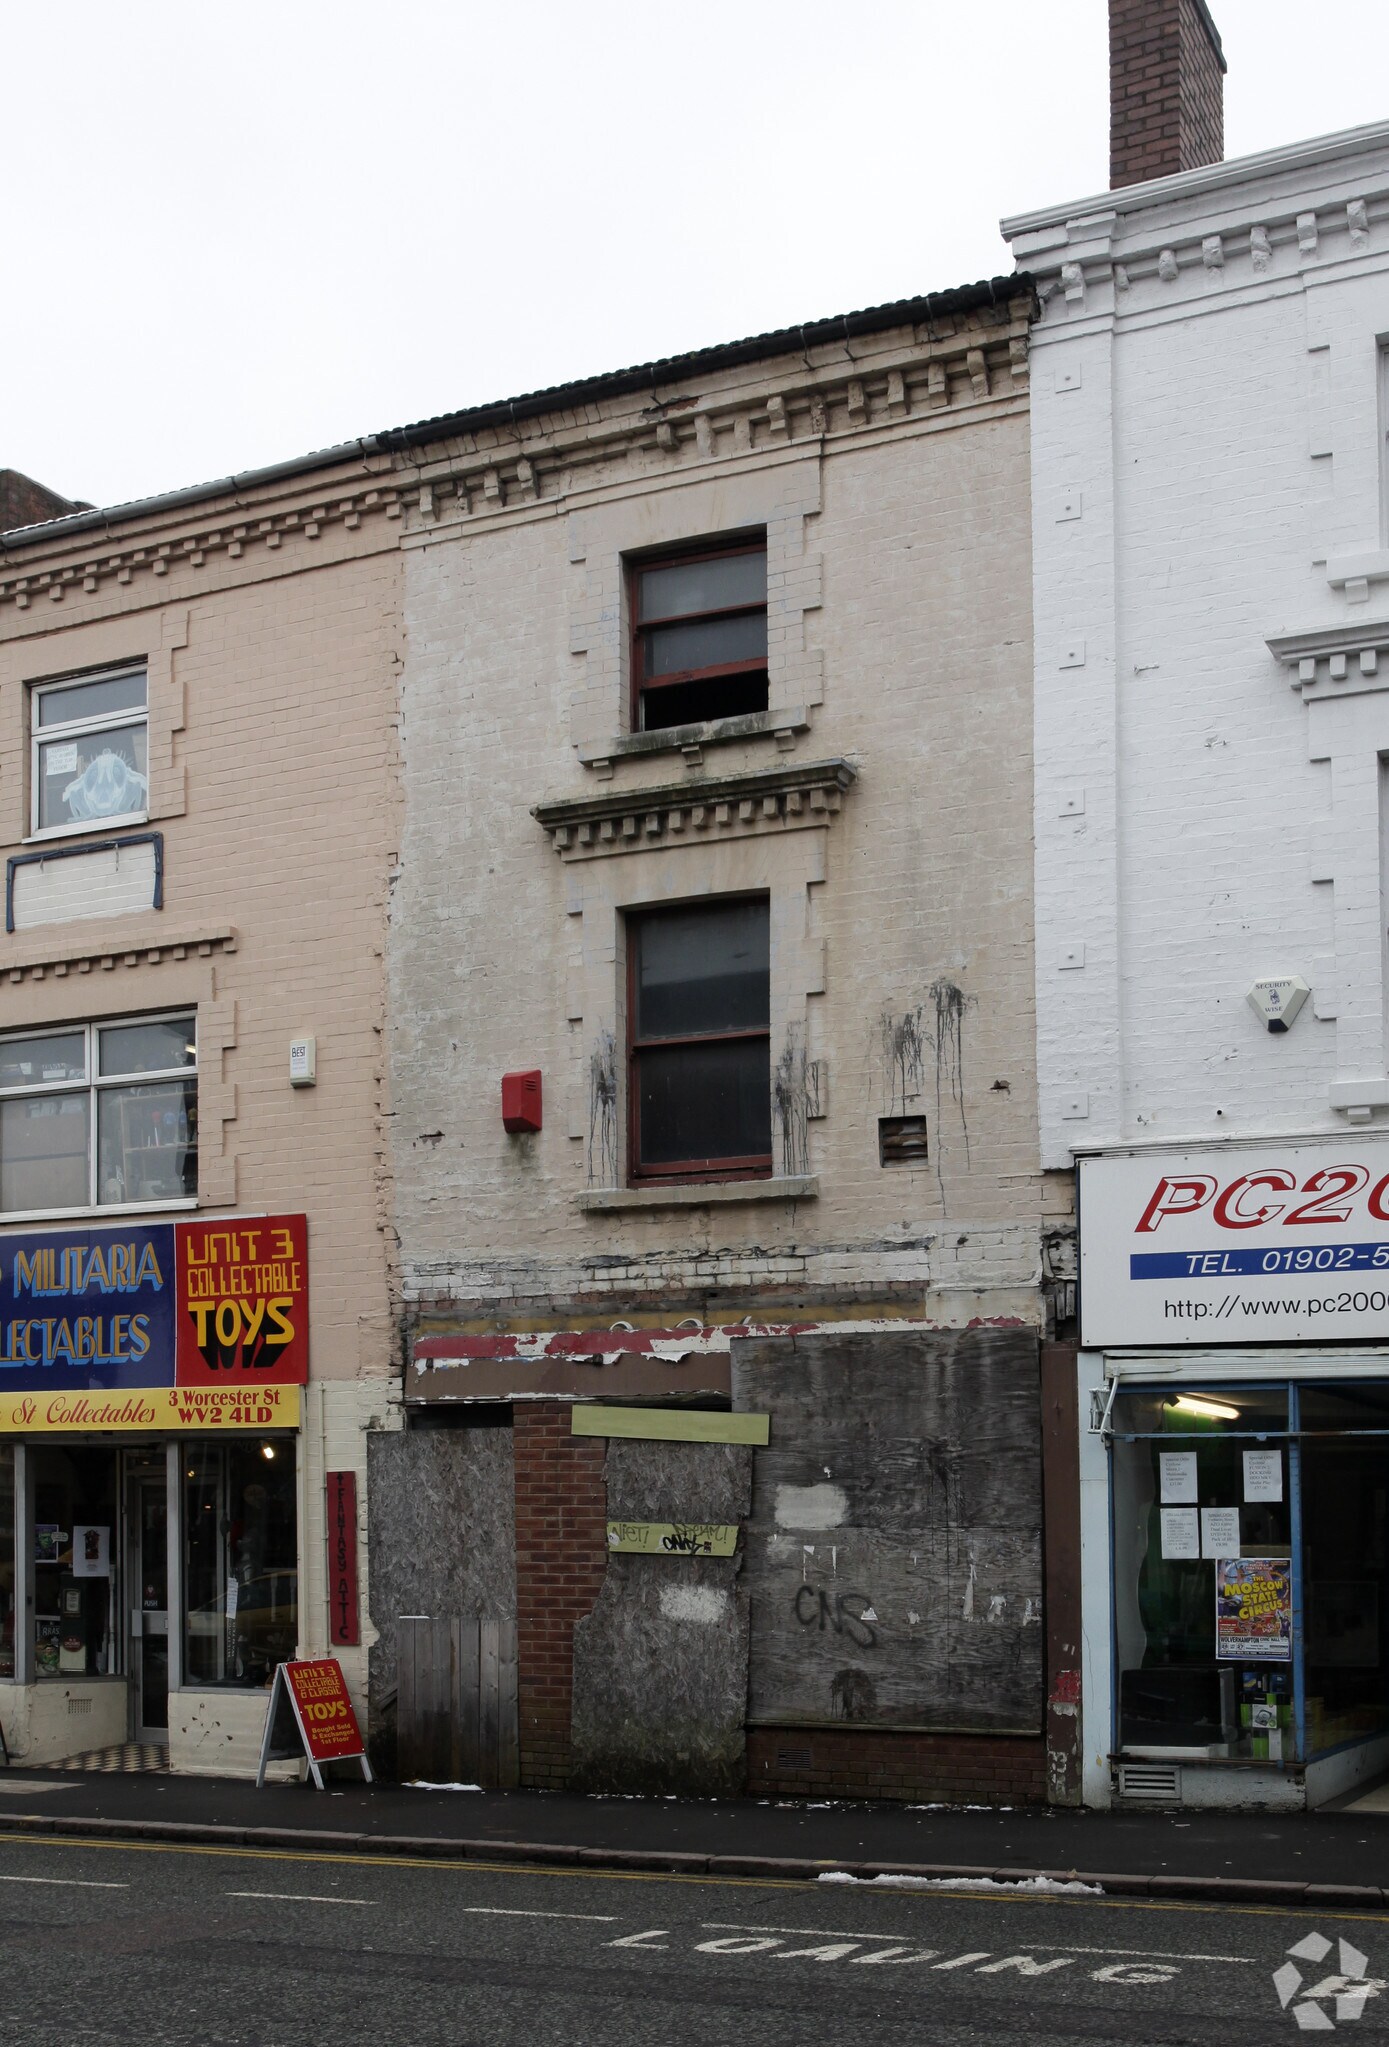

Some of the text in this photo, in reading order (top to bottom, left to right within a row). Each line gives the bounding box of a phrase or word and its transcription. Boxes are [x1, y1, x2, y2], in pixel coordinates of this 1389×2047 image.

[1255, 981, 1291, 990] SECURITY
[292, 1047, 305, 1057] BEST
[1134, 1163, 1389, 1233] PC2
[187, 1229, 293, 1264] UNIT 3
[14, 1242, 163, 1298] MILITARIA
[1186, 1247, 1389, 1275] TEL. 01902-5
[188, 1262, 301, 1297] COLLECTABLE
[1164, 1291, 1389, 1320] http://www.pc200
[188, 1297, 295, 1347] TOYS
[169, 1388, 280, 1407] 3 Worcester St
[12, 1396, 155, 1425] St Collectables
[178, 1407, 272, 1423] WV2 4LD
[337, 1487, 346, 1573] FANTASY
[1224, 1581, 1283, 1597] MOSCOW
[1242, 1591, 1278, 1606] STATE
[338, 1578, 349, 1640] ATTIC
[1238, 1600, 1283, 1620] CIRCUS
[293, 1666, 336, 1679] UNIT 3
[295, 1676, 341, 1690] COLLECTABLE
[309, 1685, 341, 1698] CLASSIC
[304, 1700, 347, 1720] TOYS
[311, 1725, 335, 1734] Bought
[319, 1729, 355, 1739] Exchanged
[600, 1930, 1180, 1985] LOADING
